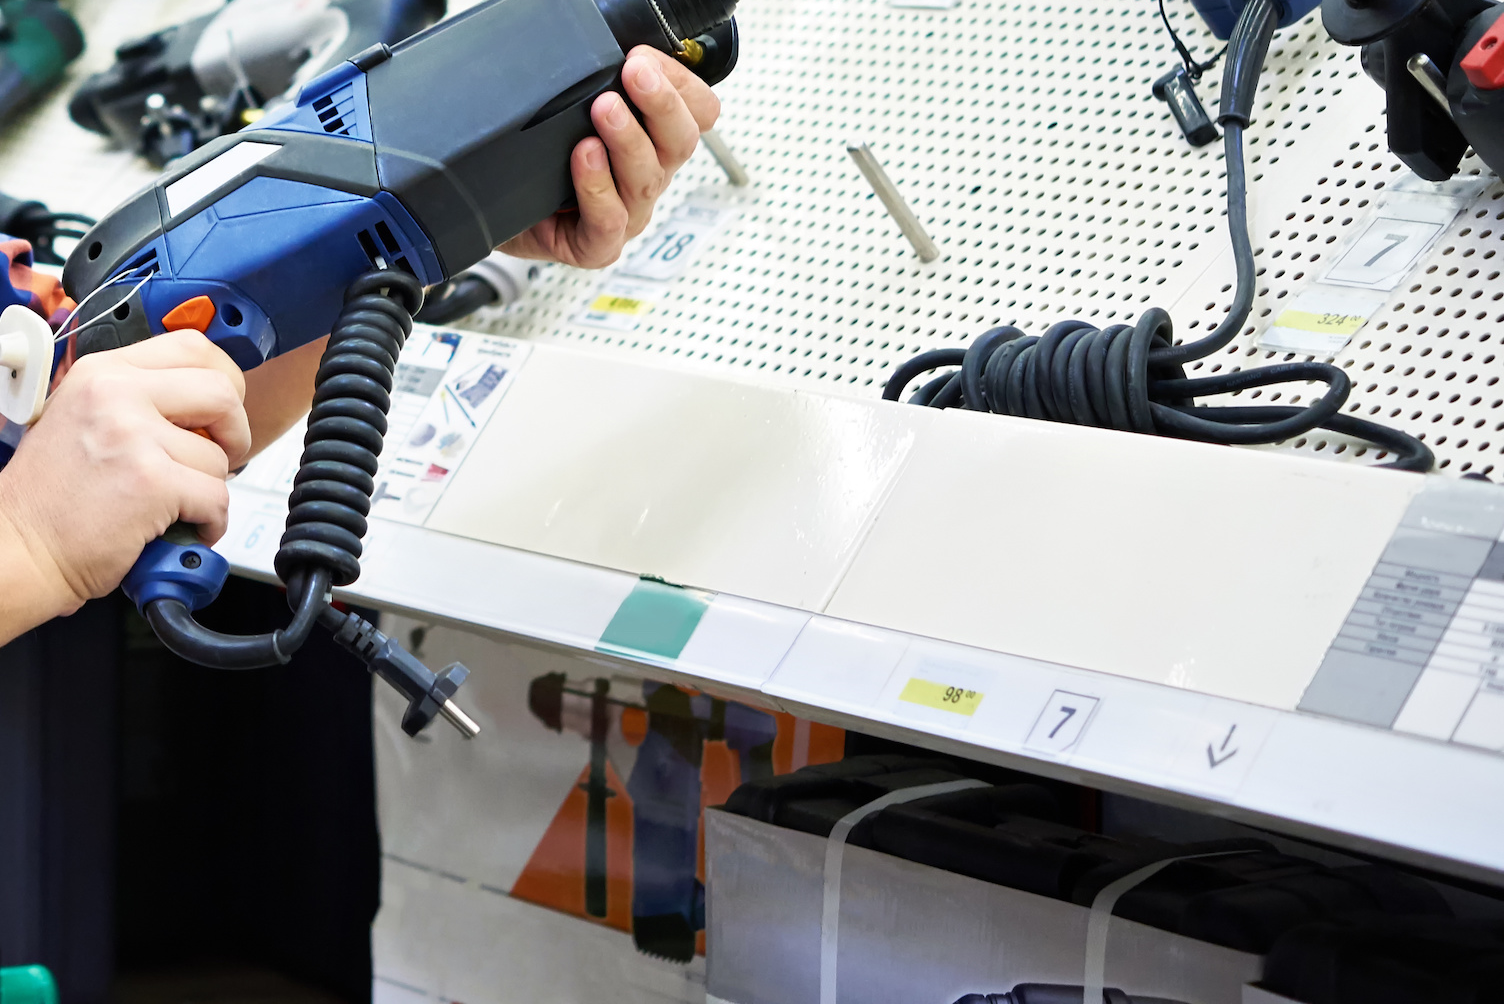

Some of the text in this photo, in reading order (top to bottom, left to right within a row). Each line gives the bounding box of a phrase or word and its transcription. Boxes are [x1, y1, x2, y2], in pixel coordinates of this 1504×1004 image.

[649, 231, 695, 261] 18
[1363, 233, 1409, 267] 7
[1317, 312, 1348, 326] 324
[942, 686, 964, 704] 98
[1048, 706, 1077, 739] 7
